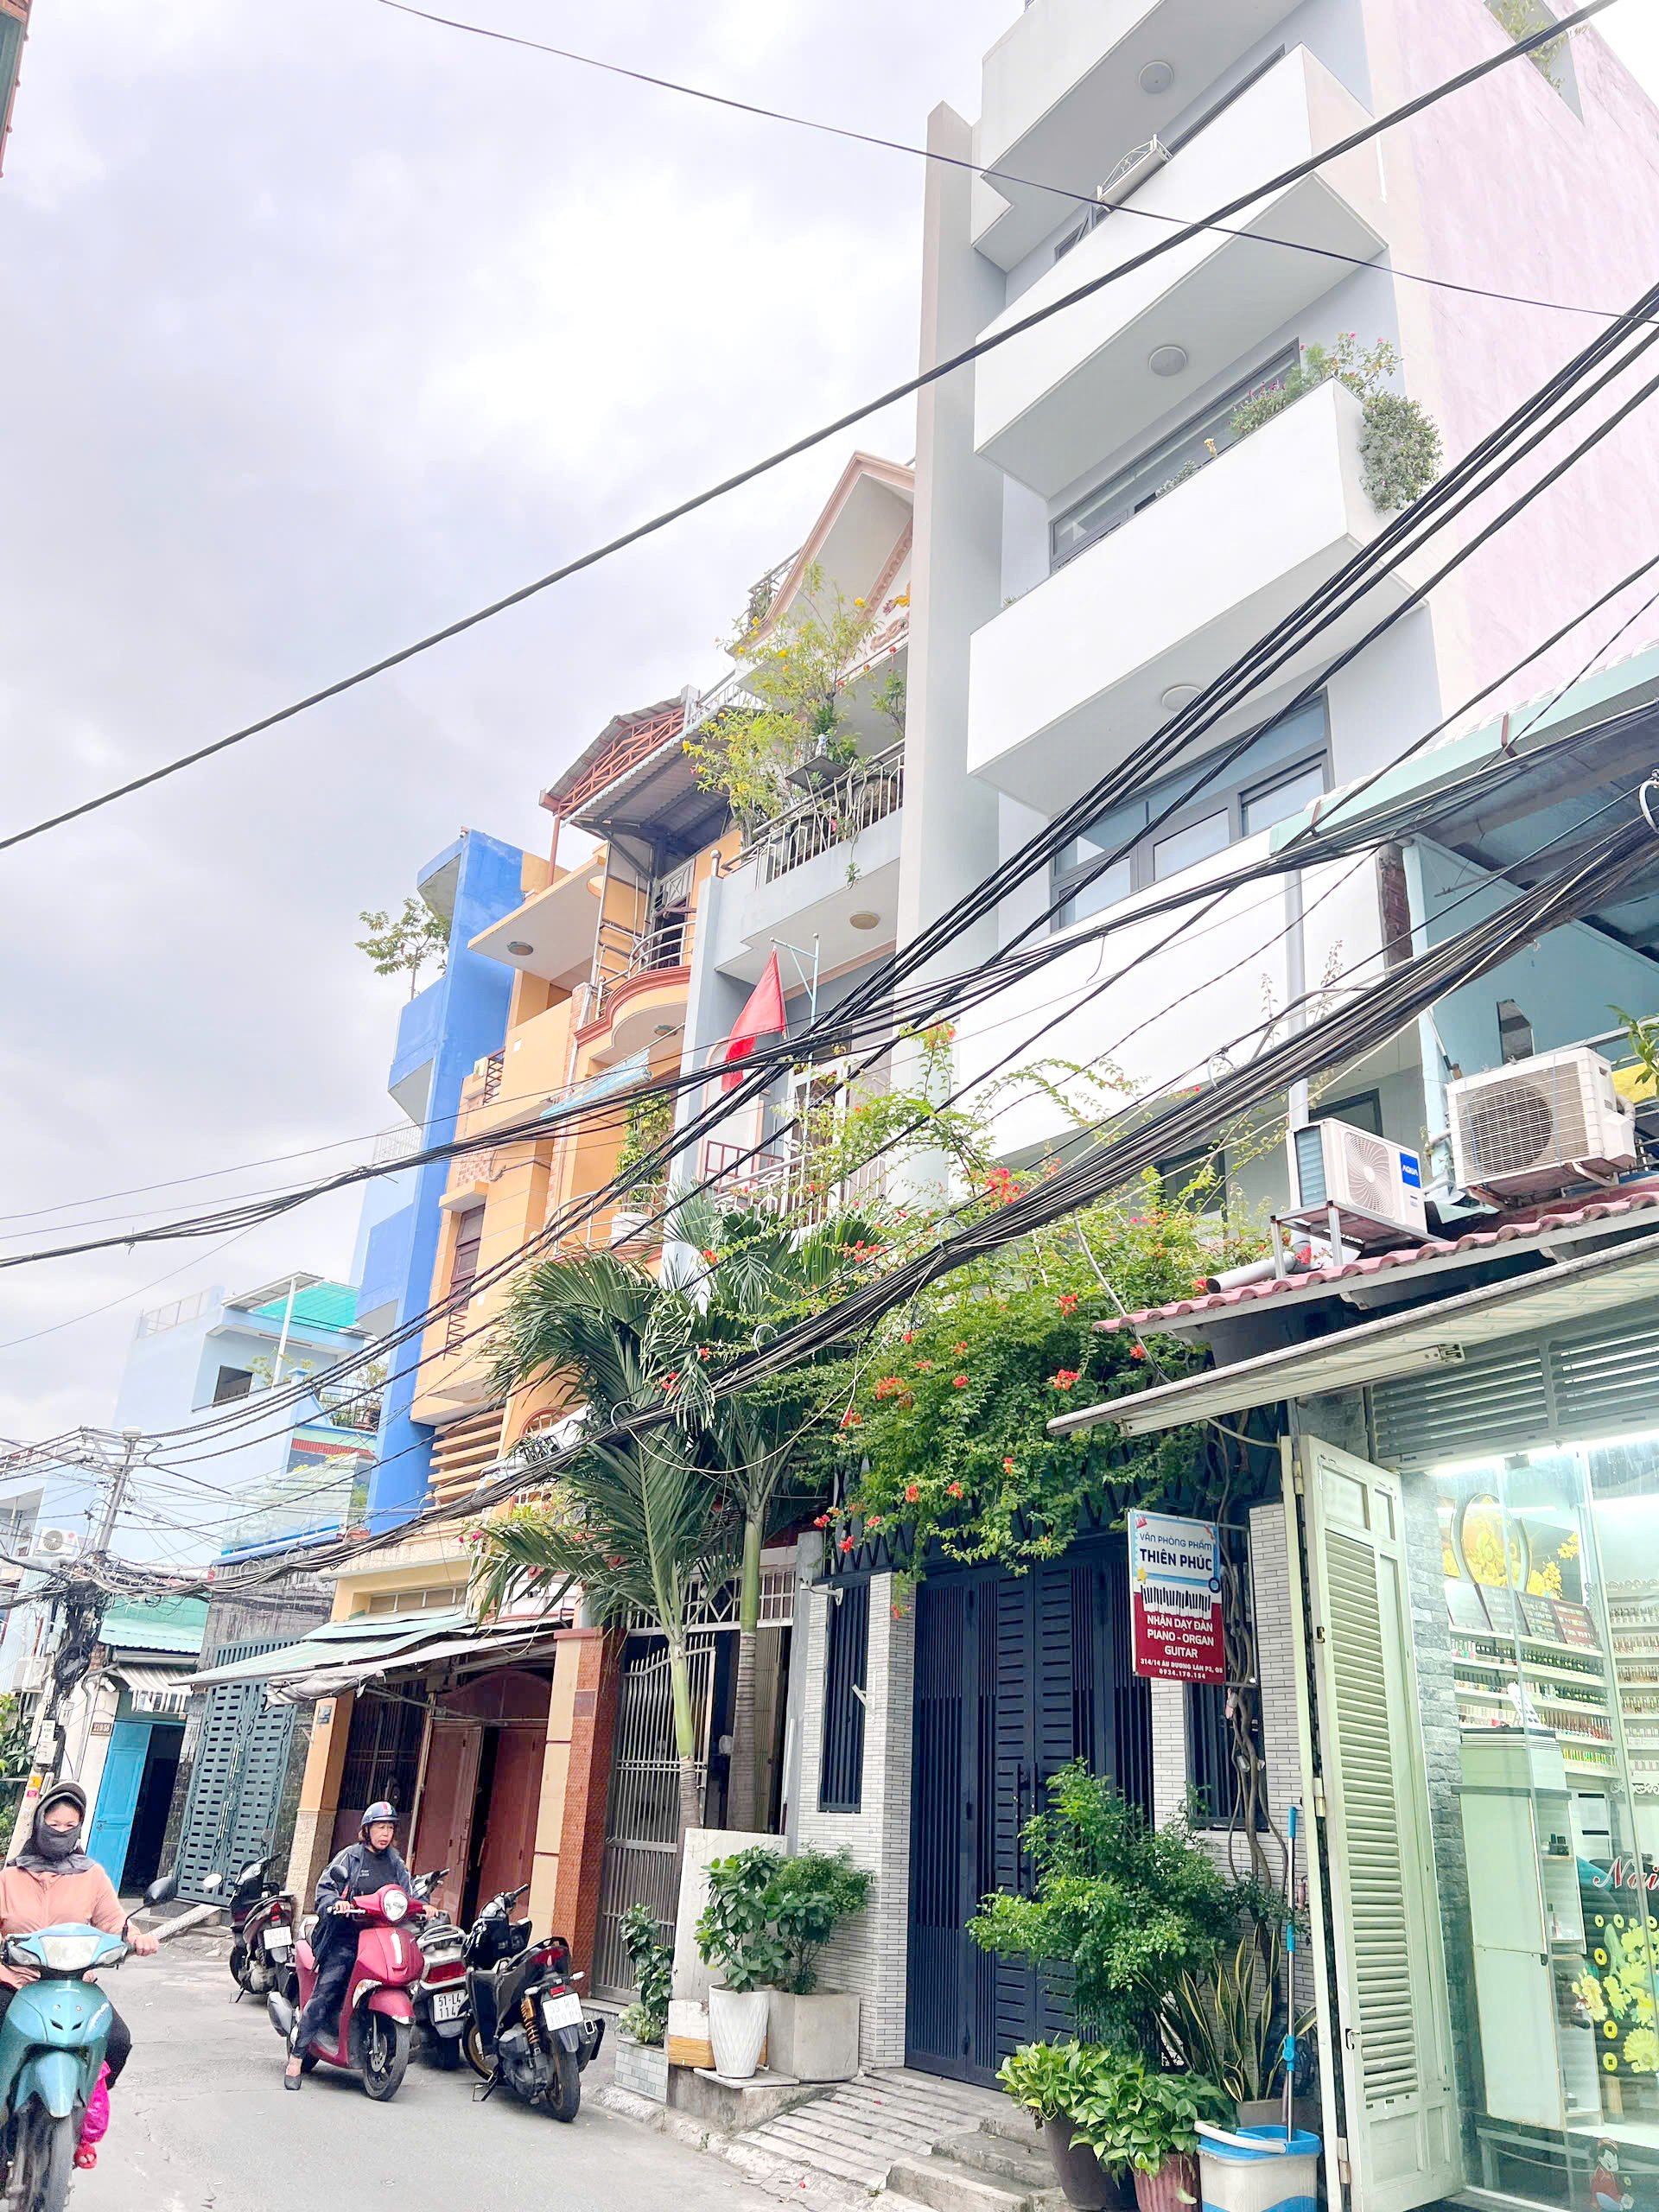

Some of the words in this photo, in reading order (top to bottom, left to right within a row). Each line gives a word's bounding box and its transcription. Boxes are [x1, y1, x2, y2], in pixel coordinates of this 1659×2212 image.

[1402, 1165, 1418, 1176] AQUA
[1158, 1535, 1186, 1547] PHÒNG
[1140, 1548, 1176, 1567] THIÊN
[1179, 1554, 1212, 1571] PHÚC
[1147, 1614, 1173, 1628] NHẬN
[1174, 1618, 1192, 1630] DẠY
[1193, 1619, 1213, 1632] ĐÀN
[1147, 1629, 1175, 1642] PIANO
[1182, 1634, 1214, 1646] ORGAN
[1164, 1645, 1198, 1658] GUITAR
